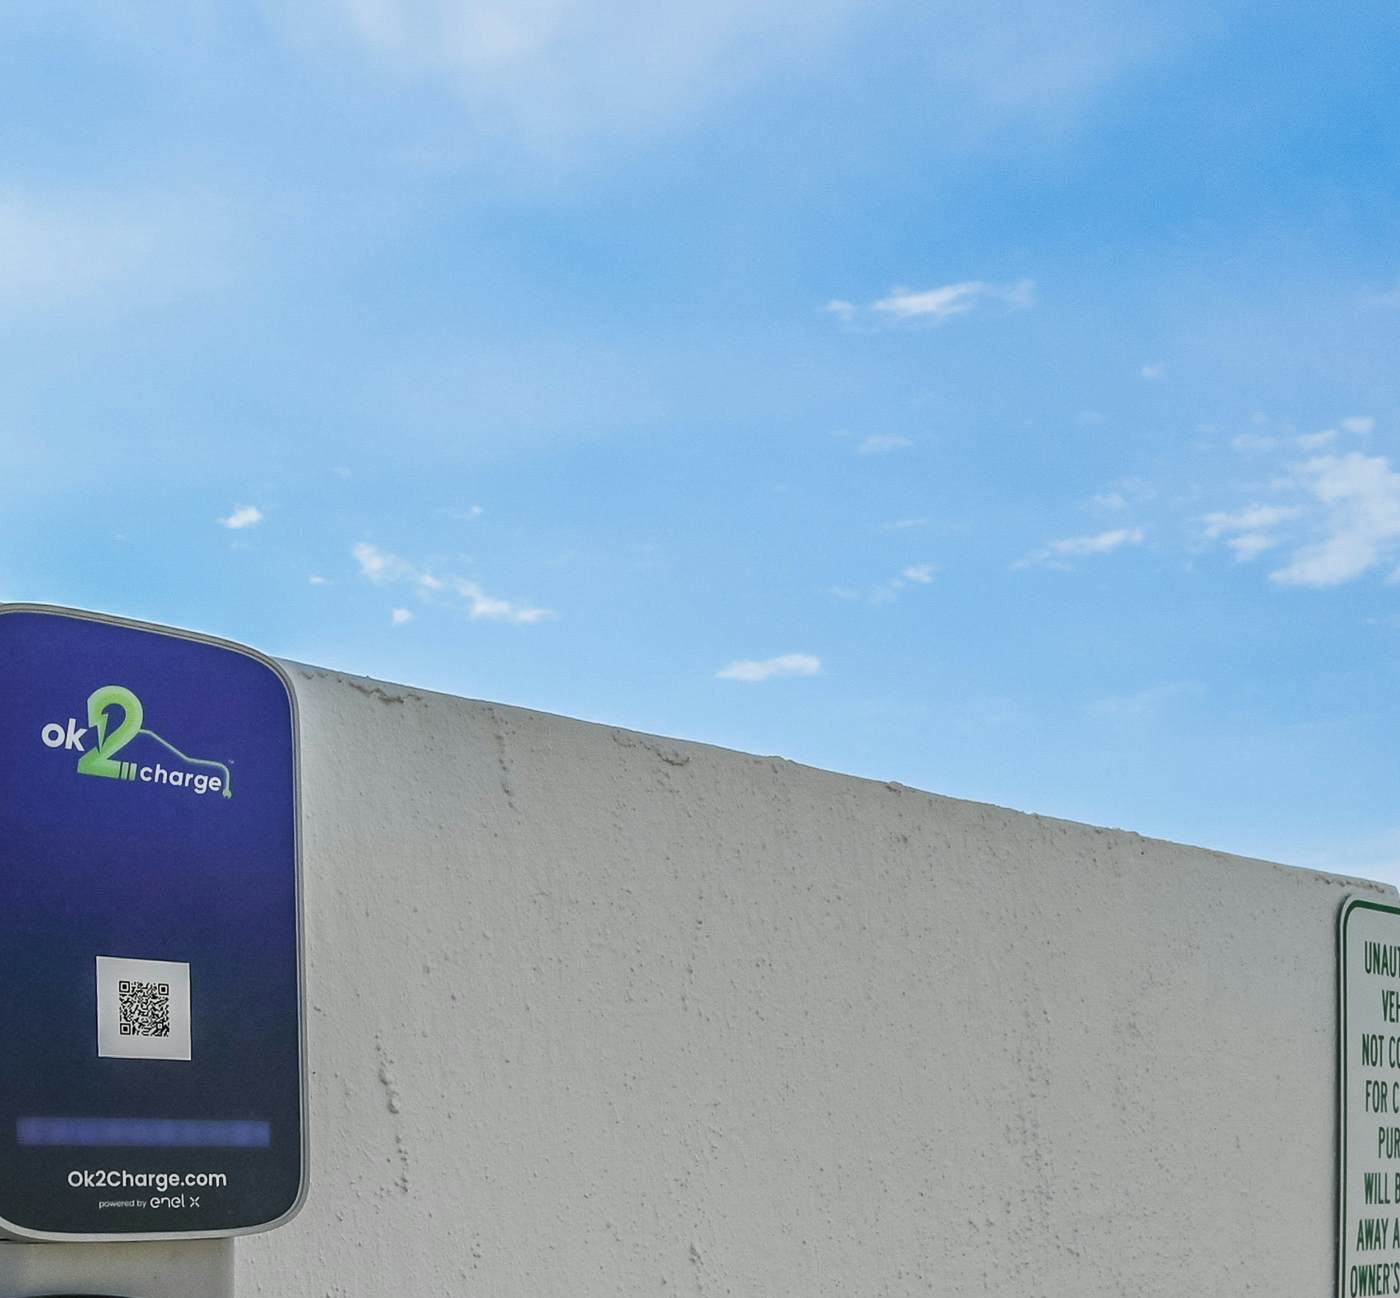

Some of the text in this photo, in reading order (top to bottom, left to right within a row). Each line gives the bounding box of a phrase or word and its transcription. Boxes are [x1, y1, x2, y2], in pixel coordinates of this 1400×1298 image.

[41, 718, 88, 751] ok
[139, 764, 222, 794] charge
[1362, 1033, 1384, 1067] NOT
[1365, 1080, 1400, 1114] FOR C
[1378, 1126, 1400, 1159] PUR
[67, 1170, 227, 1192] Ok2Charge.com
[1364, 1172, 1391, 1204] WILL
[98, 1200, 135, 1210] powered
[136, 1200, 147, 1209] by
[150, 1193, 185, 1208] enel
[1356, 1217, 1389, 1251] AWAY
[1350, 1261, 1400, 1298] OWNER'S
